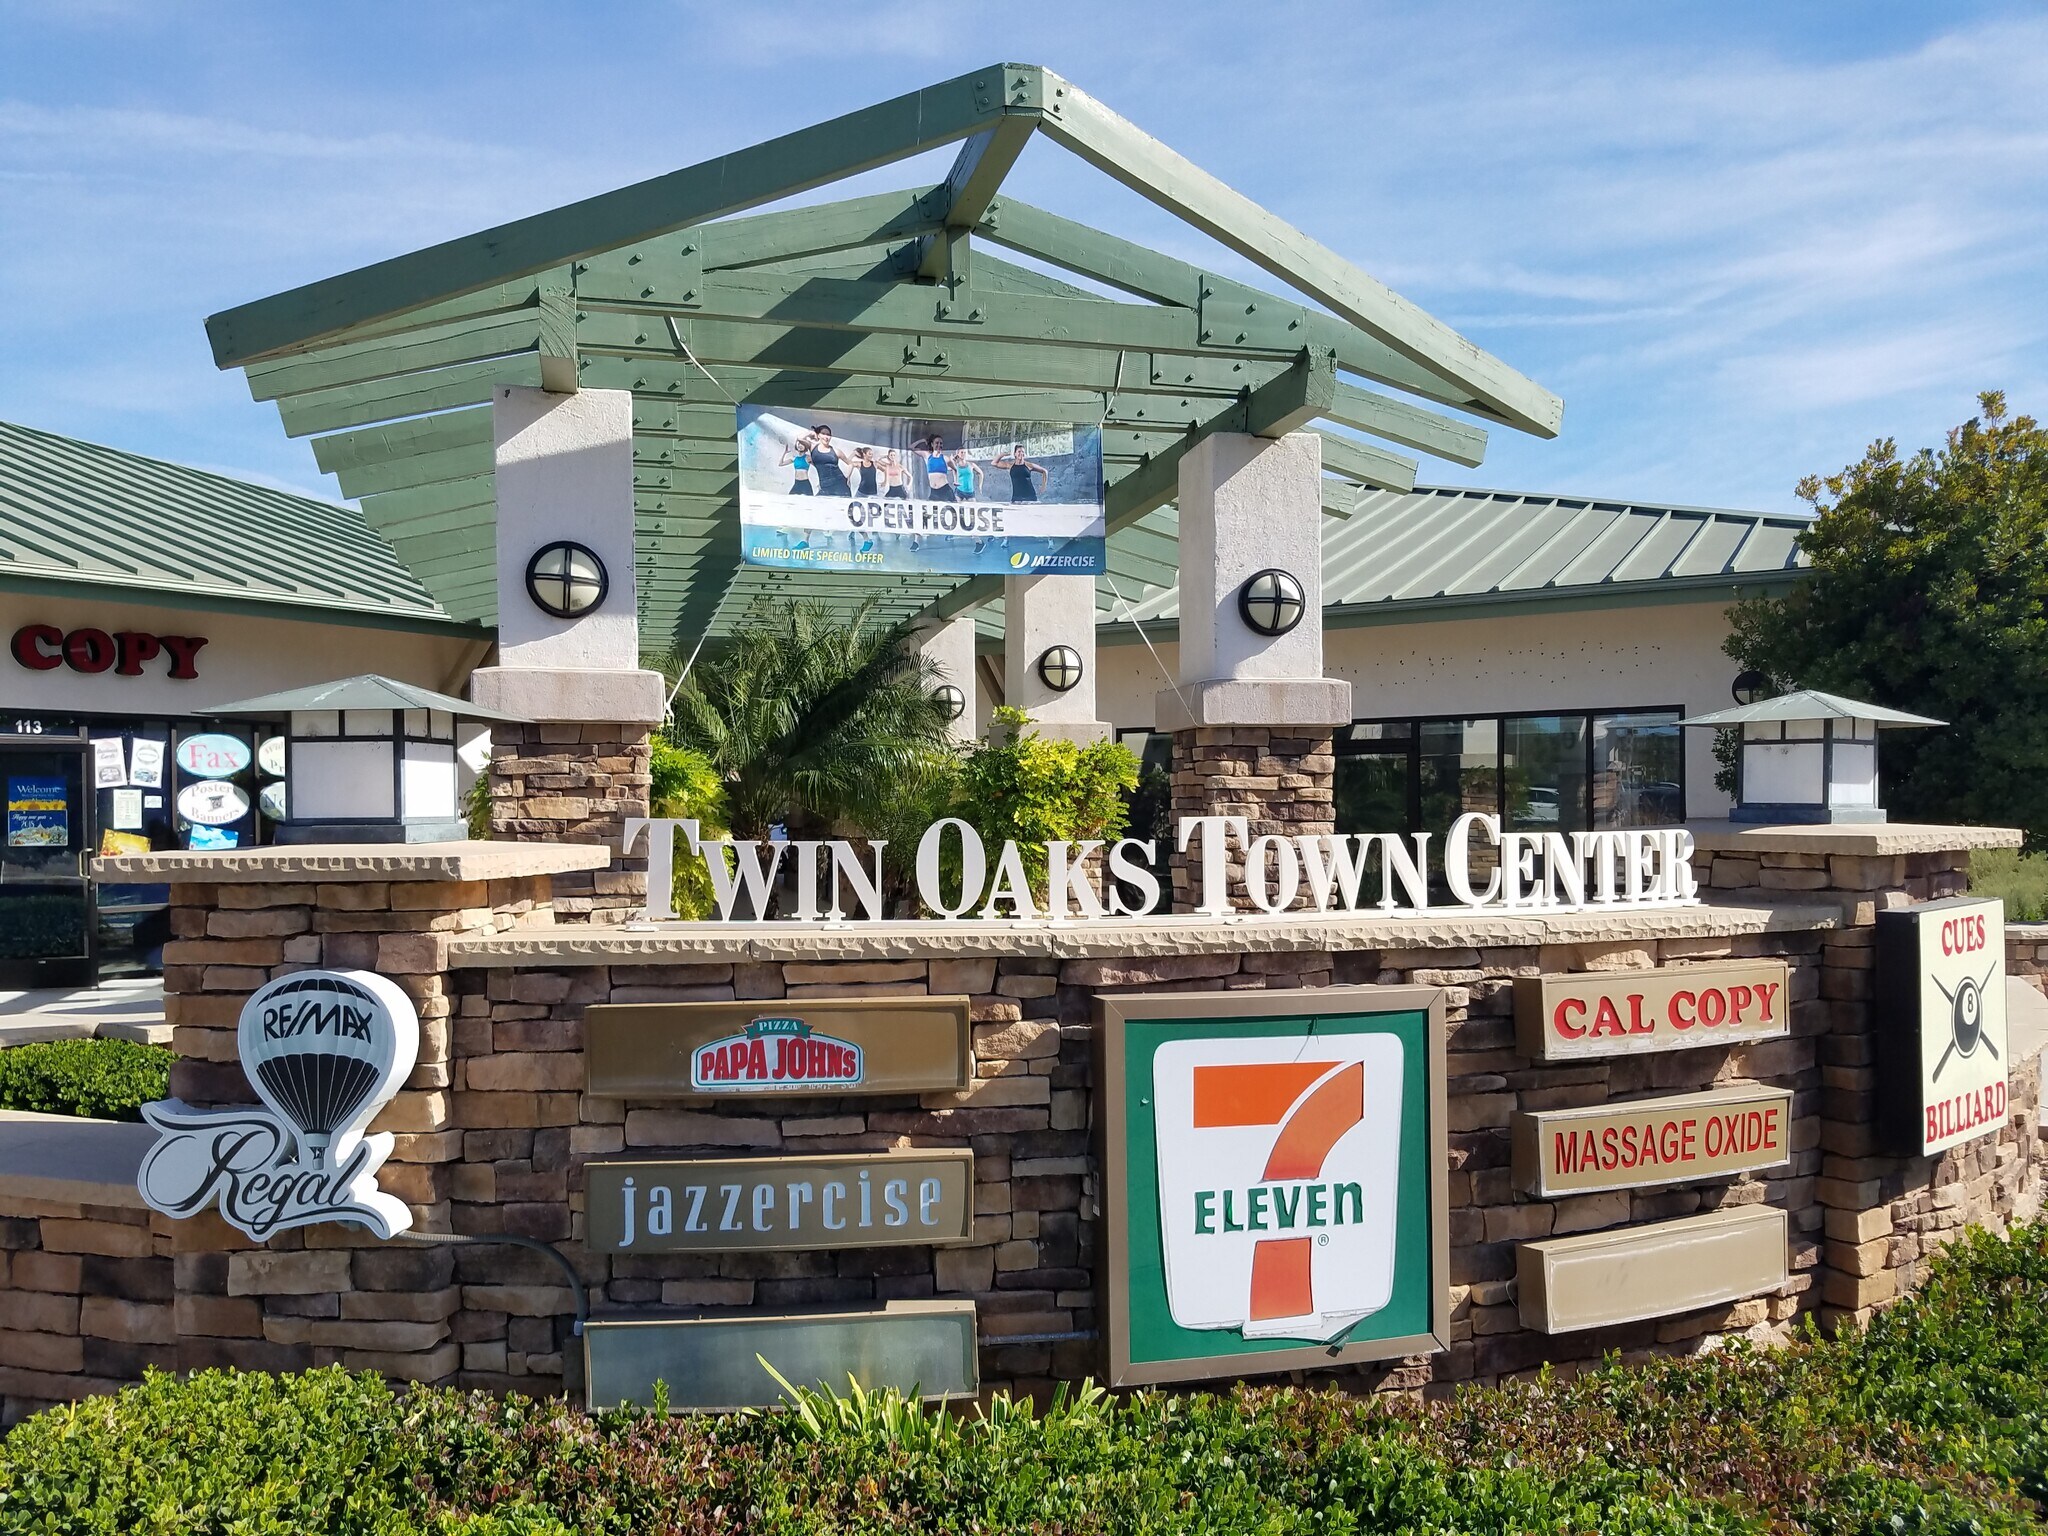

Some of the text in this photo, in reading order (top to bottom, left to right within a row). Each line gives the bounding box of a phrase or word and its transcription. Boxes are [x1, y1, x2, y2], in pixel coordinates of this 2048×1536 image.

[848, 501, 1004, 532] OPEN HOUSE
[752, 546, 884, 564] LIMITED TIME SPECIAL OFFER
[1030, 555, 1095, 568] JAZZERCISE
[10, 624, 209, 680] COPY
[15, 720, 43, 734] 113
[189, 744, 239, 769] Fax
[17, 785, 62, 793] Welcome
[191, 783, 232, 797] Poster
[191, 807, 240, 823] Banners
[1941, 913, 1986, 958] CUES
[264, 1000, 373, 1044] RE/MAX
[1553, 982, 1780, 1041] CAL COPY
[1967, 996, 1975, 1014] 8
[758, 1019, 799, 1032] PIZZA
[701, 1042, 768, 1080] PAPA
[1925, 1080, 2007, 1144] BILLIARD
[1555, 1108, 1778, 1175] MASSAGE OXIDE
[146, 1112, 385, 1236] Regal
[1193, 1060, 1365, 1321] 7
[618, 1169, 942, 1248] jazzercise
